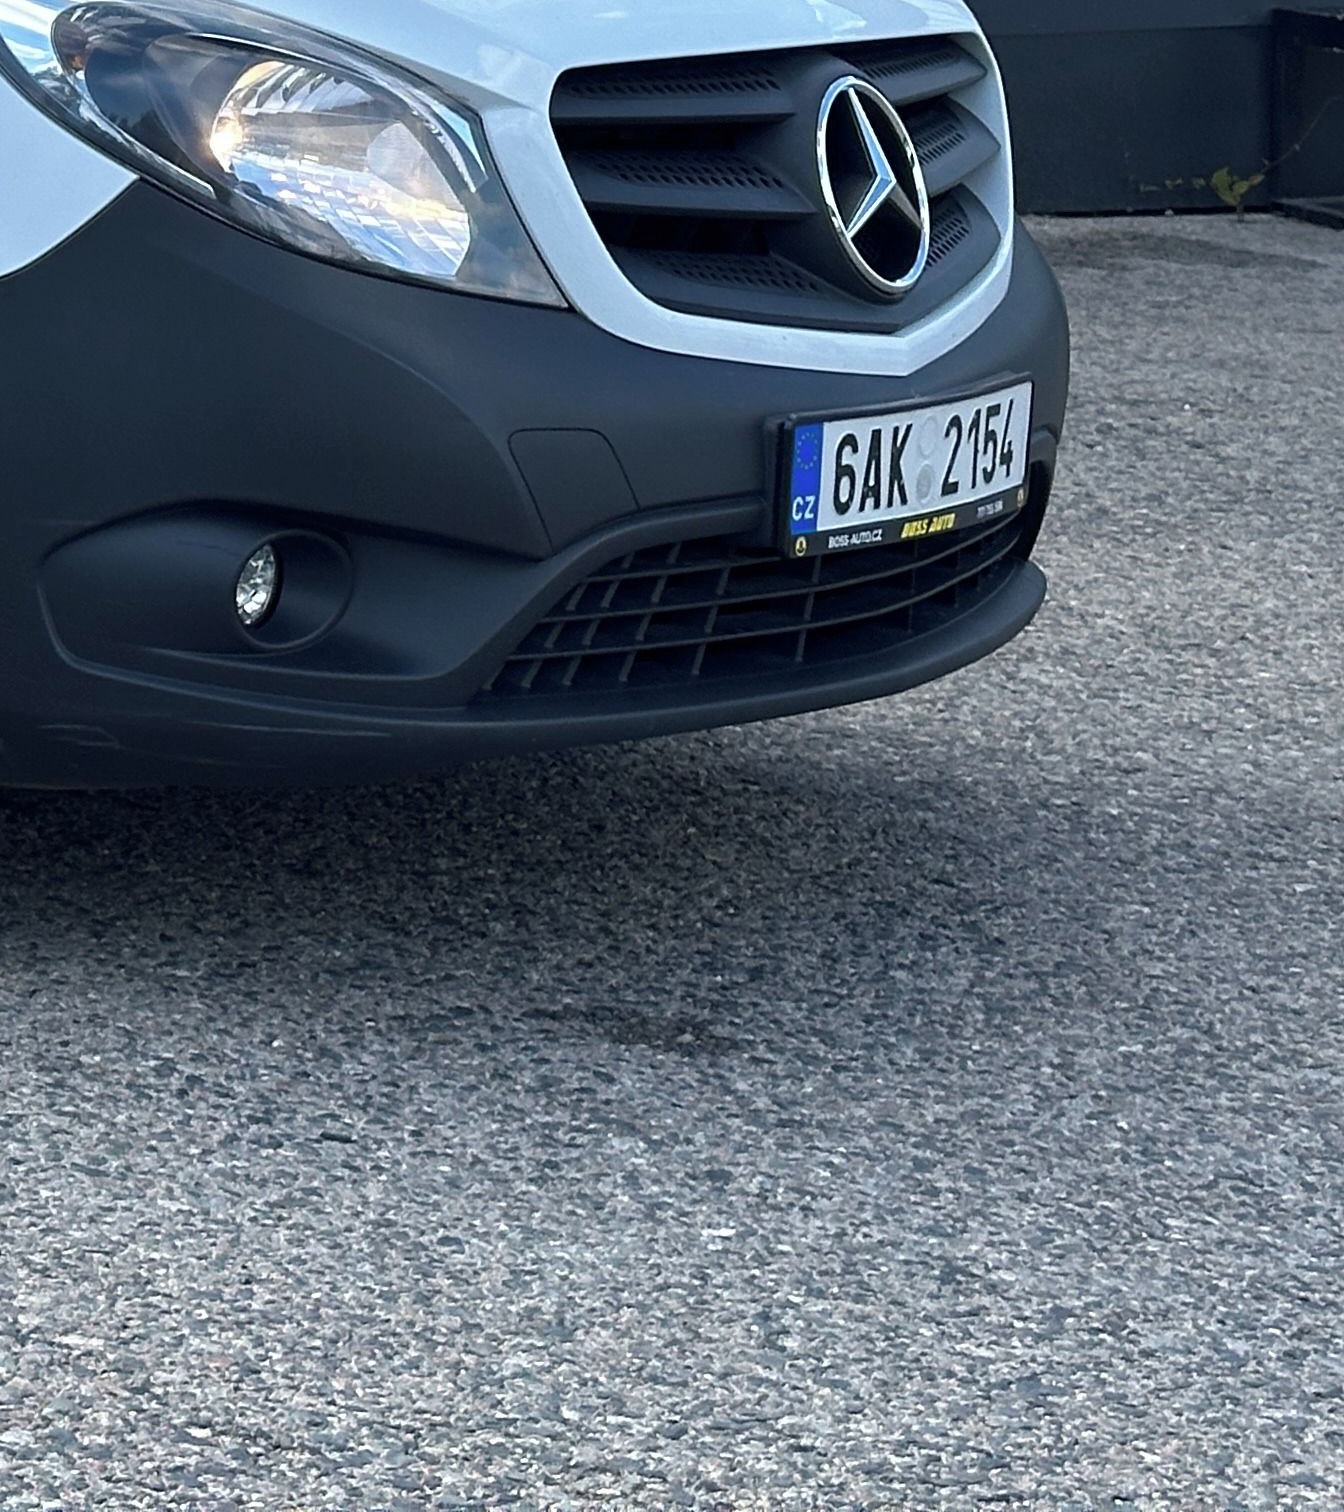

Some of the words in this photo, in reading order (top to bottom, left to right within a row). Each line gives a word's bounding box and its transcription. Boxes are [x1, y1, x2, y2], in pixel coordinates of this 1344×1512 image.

[833, 422, 913, 516] 6AK
[940, 398, 1014, 497] 2154
[792, 495, 816, 521] CZ
[900, 518, 929, 539] BOSS
